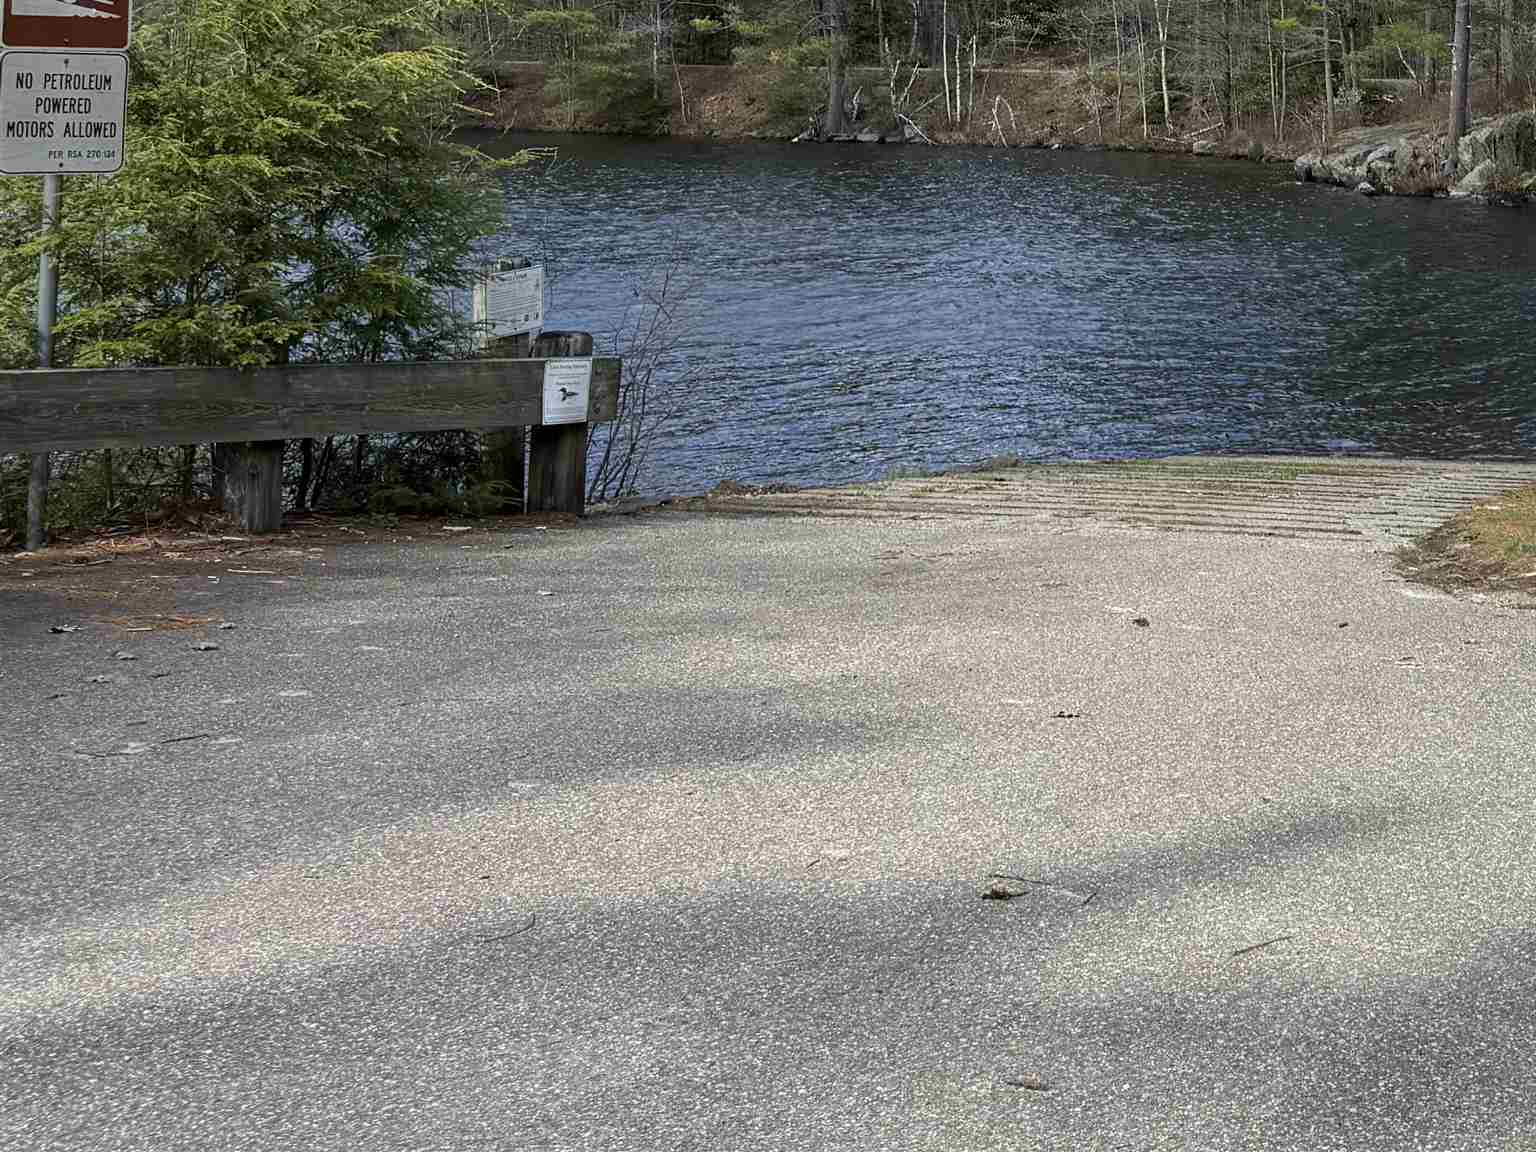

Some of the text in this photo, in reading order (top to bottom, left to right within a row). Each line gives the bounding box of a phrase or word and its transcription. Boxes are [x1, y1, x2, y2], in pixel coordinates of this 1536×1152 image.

[15, 72, 112, 90] NO PETROLEUM
[35, 97, 92, 114] POWERED
[6, 120, 117, 138] MOTORS ALLOWED
[48, 150, 64, 159] PER
[67, 150, 83, 159] RSA
